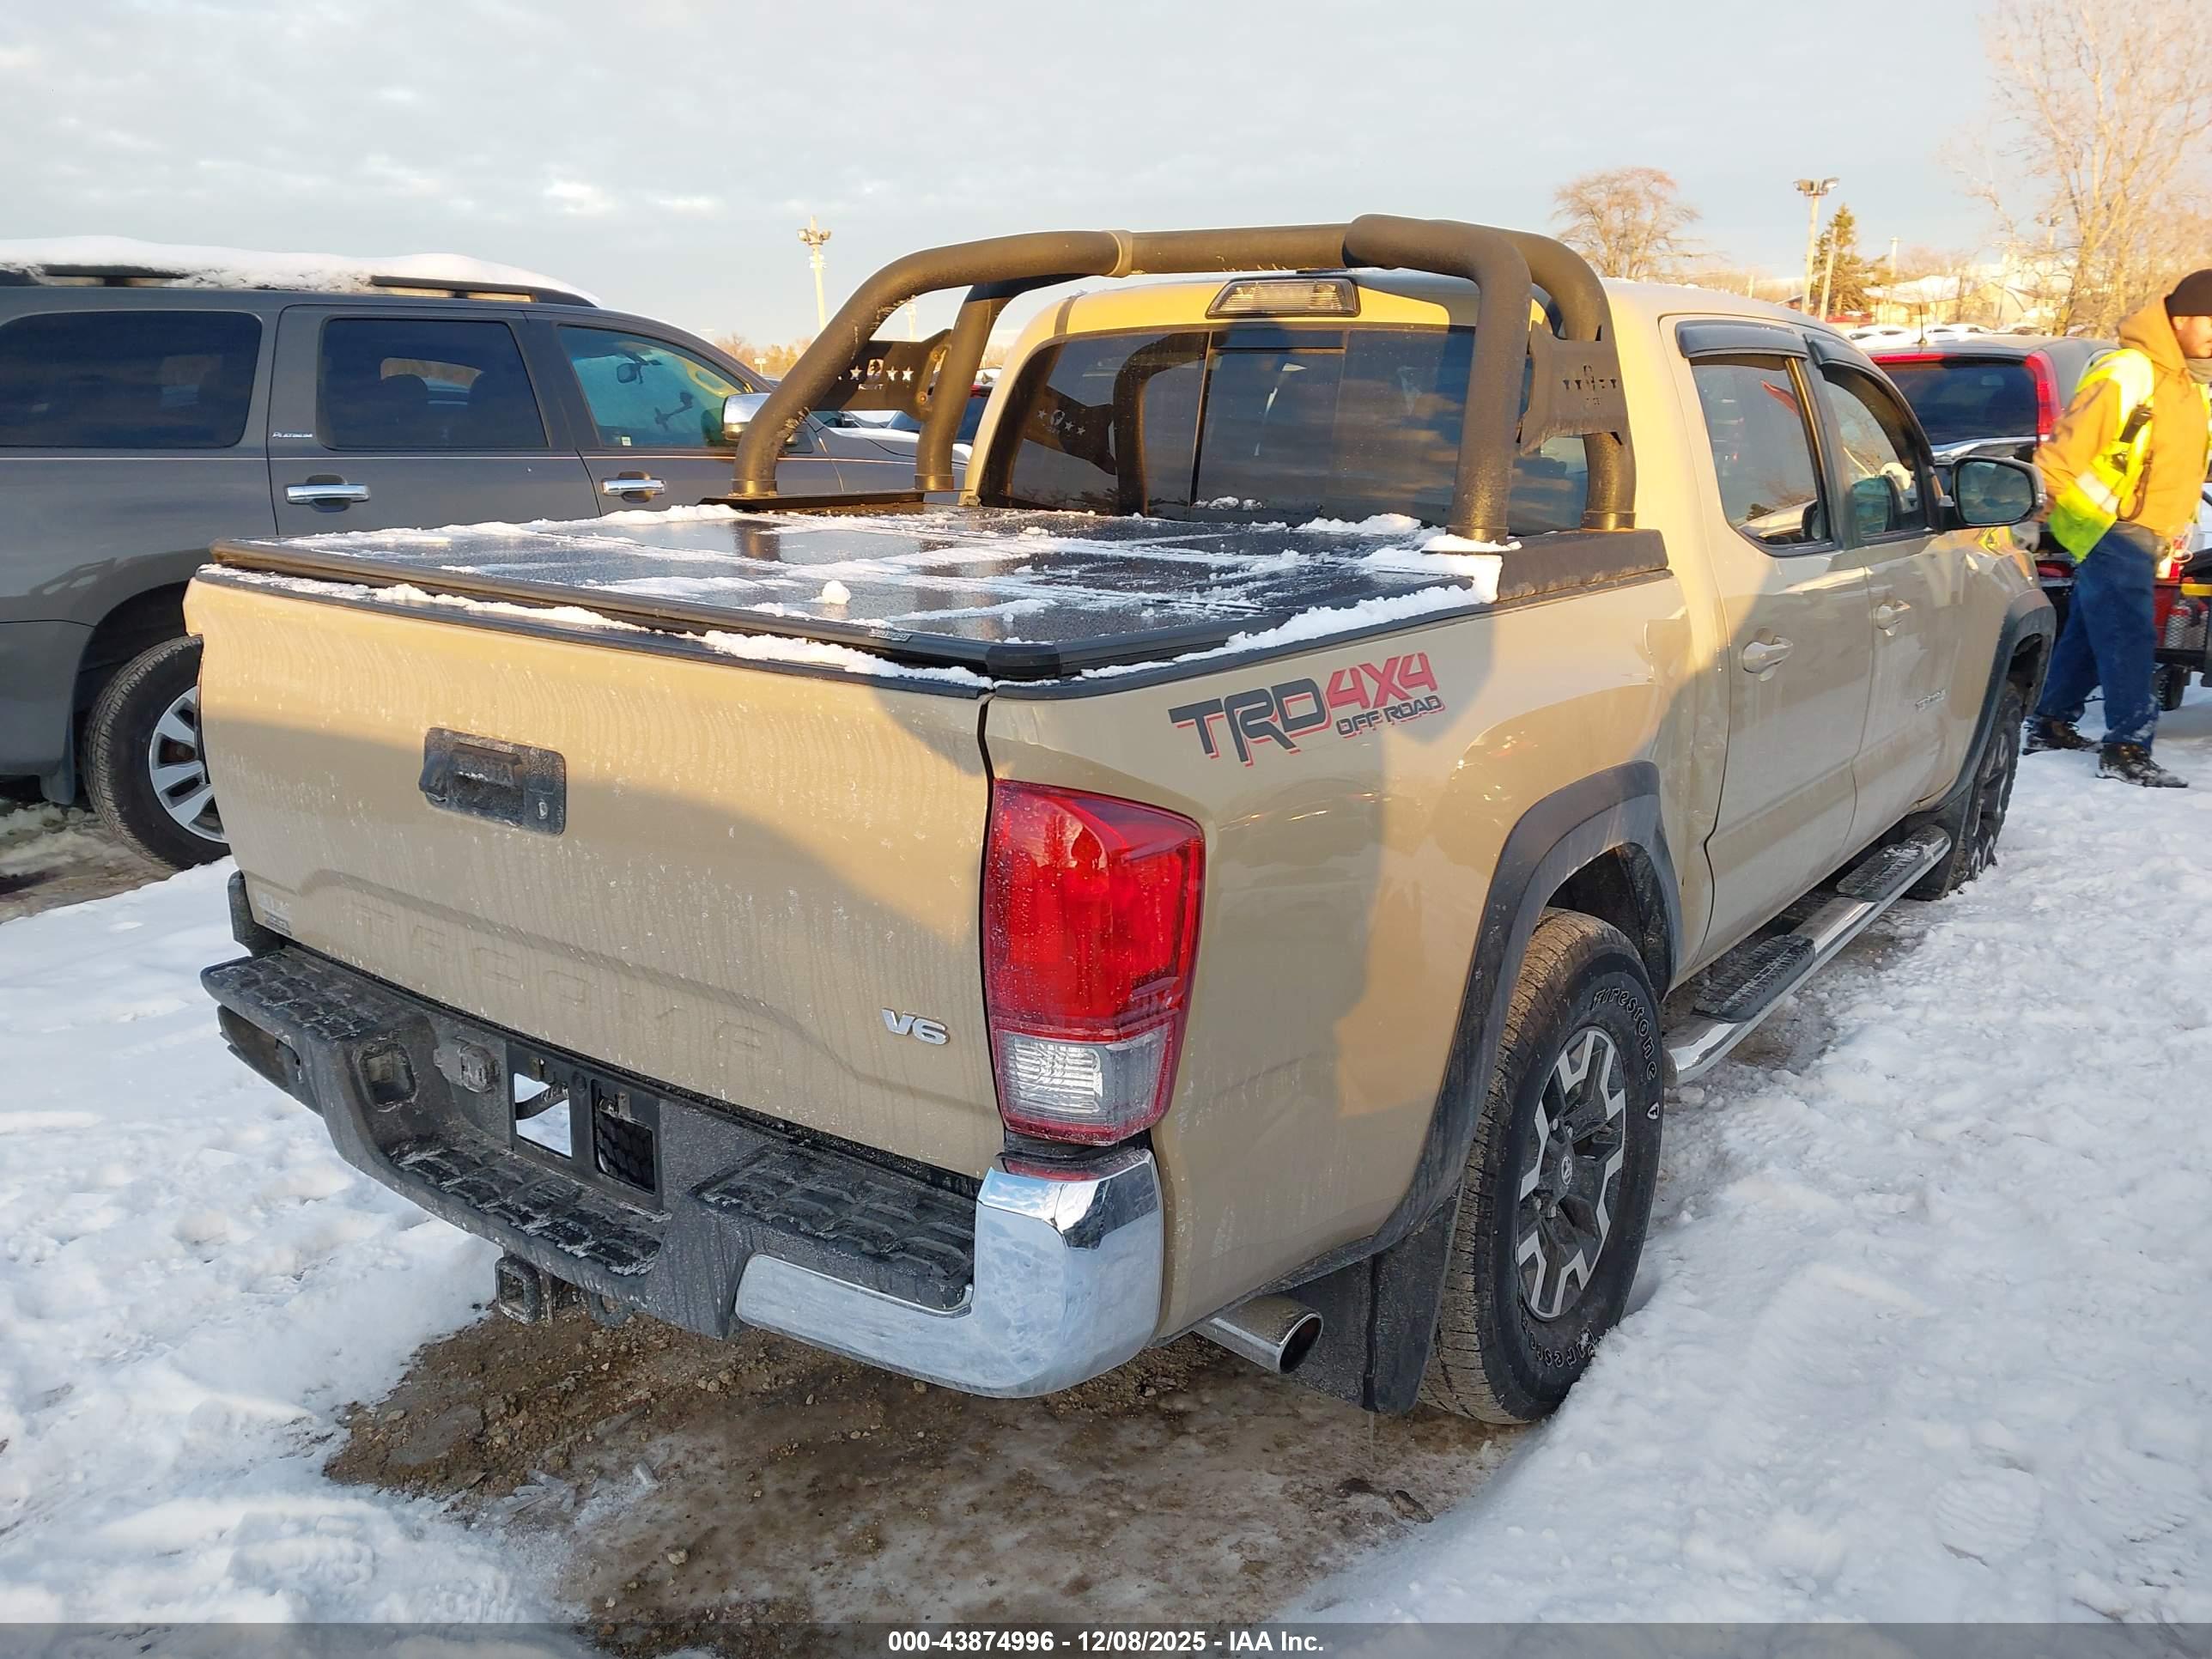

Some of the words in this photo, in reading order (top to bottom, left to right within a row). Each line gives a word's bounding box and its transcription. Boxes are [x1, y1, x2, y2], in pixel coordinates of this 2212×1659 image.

[1168, 678, 1334, 767] TRD
[1324, 652, 1439, 711] 4X4
[1336, 710, 1383, 738] OFF
[1382, 695, 1446, 726] ROAD
[880, 1007, 950, 1045] V6
[1590, 987, 1657, 1081] Firestone
